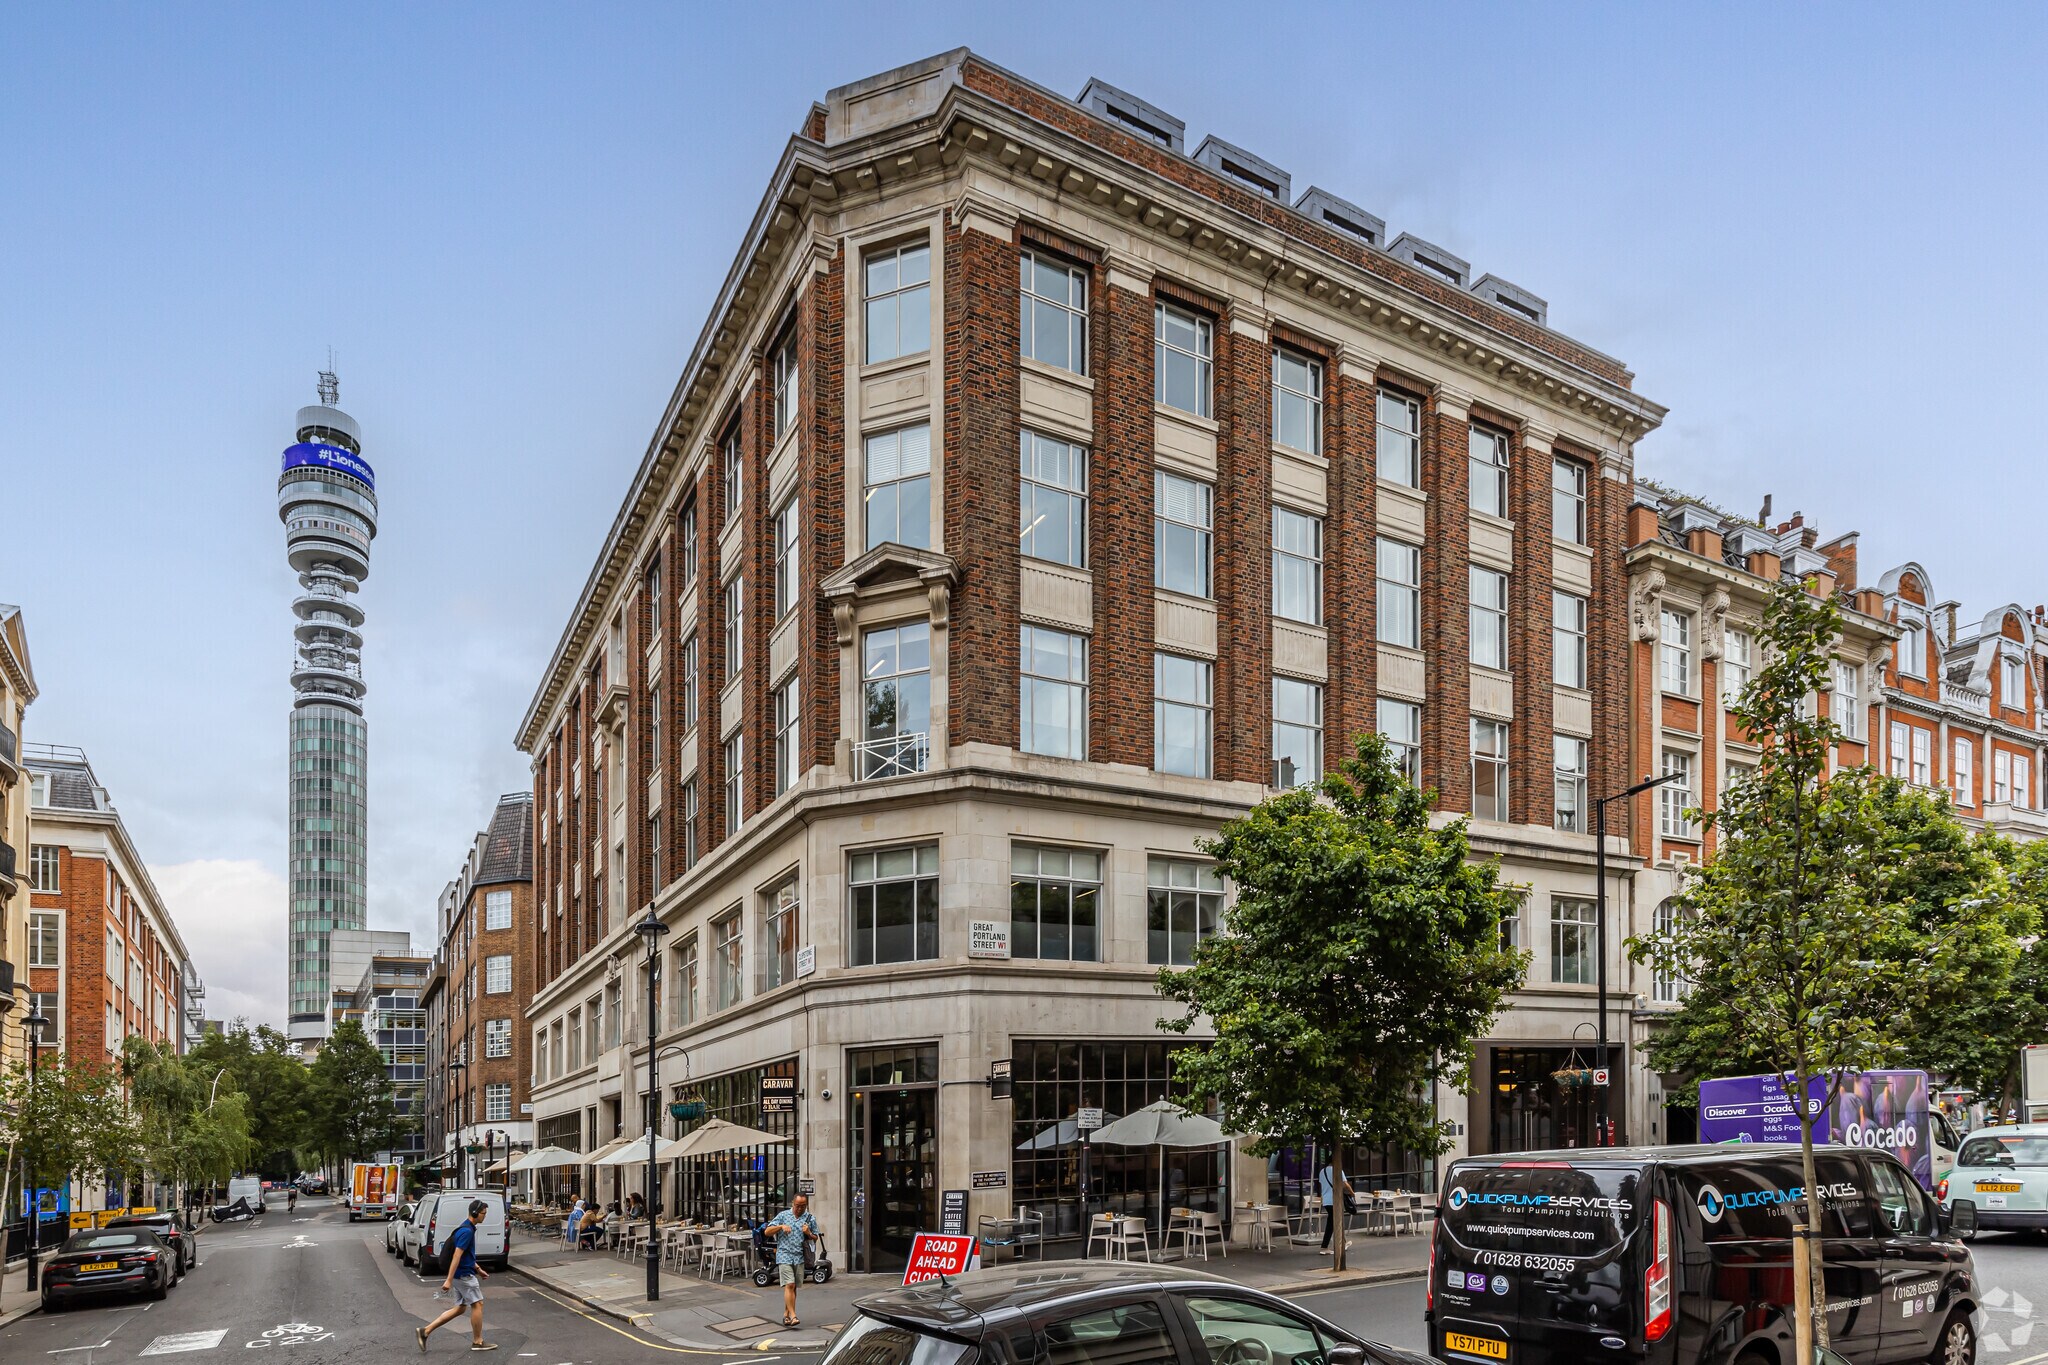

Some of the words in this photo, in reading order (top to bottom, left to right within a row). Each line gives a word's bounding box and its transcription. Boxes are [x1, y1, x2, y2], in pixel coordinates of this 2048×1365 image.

[973, 923, 993, 931] GREAT
[973, 932, 1006, 940] PORTLAND
[973, 940, 996, 949] STREET
[762, 1080, 794, 1089] CARAVAN
[1709, 1108, 1747, 1117] Discover
[1864, 1120, 1916, 1148] ocado
[1467, 1193, 1632, 1210] QUICKPUMPSERVICES
[1724, 1182, 1856, 1209] QUICKPUMPSRVICES
[1529, 1208, 1570, 1216] Pumping
[1576, 1209, 1630, 1219] Solutions
[1766, 1207, 1788, 1217] Total
[1792, 1204, 1824, 1214] Pumg
[1826, 1200, 1860, 1211] Solutions
[1466, 1224, 1595, 1240] www.quickpumpservices.com
[924, 1240, 957, 1253] ROAD
[916, 1256, 957, 1270] AHEAD
[1484, 1253, 1521, 1267] 01628
[1524, 1256, 1575, 1272] 632055
[910, 1271, 948, 1283] CLOS
[1899, 1285, 1917, 1298] 01628
[1918, 1280, 1938, 1294] 632055
[1441, 1293, 1470, 1301] TRANSIT
[1452, 1335, 1475, 1350] YS71
[1478, 1341, 1500, 1354] PTU
